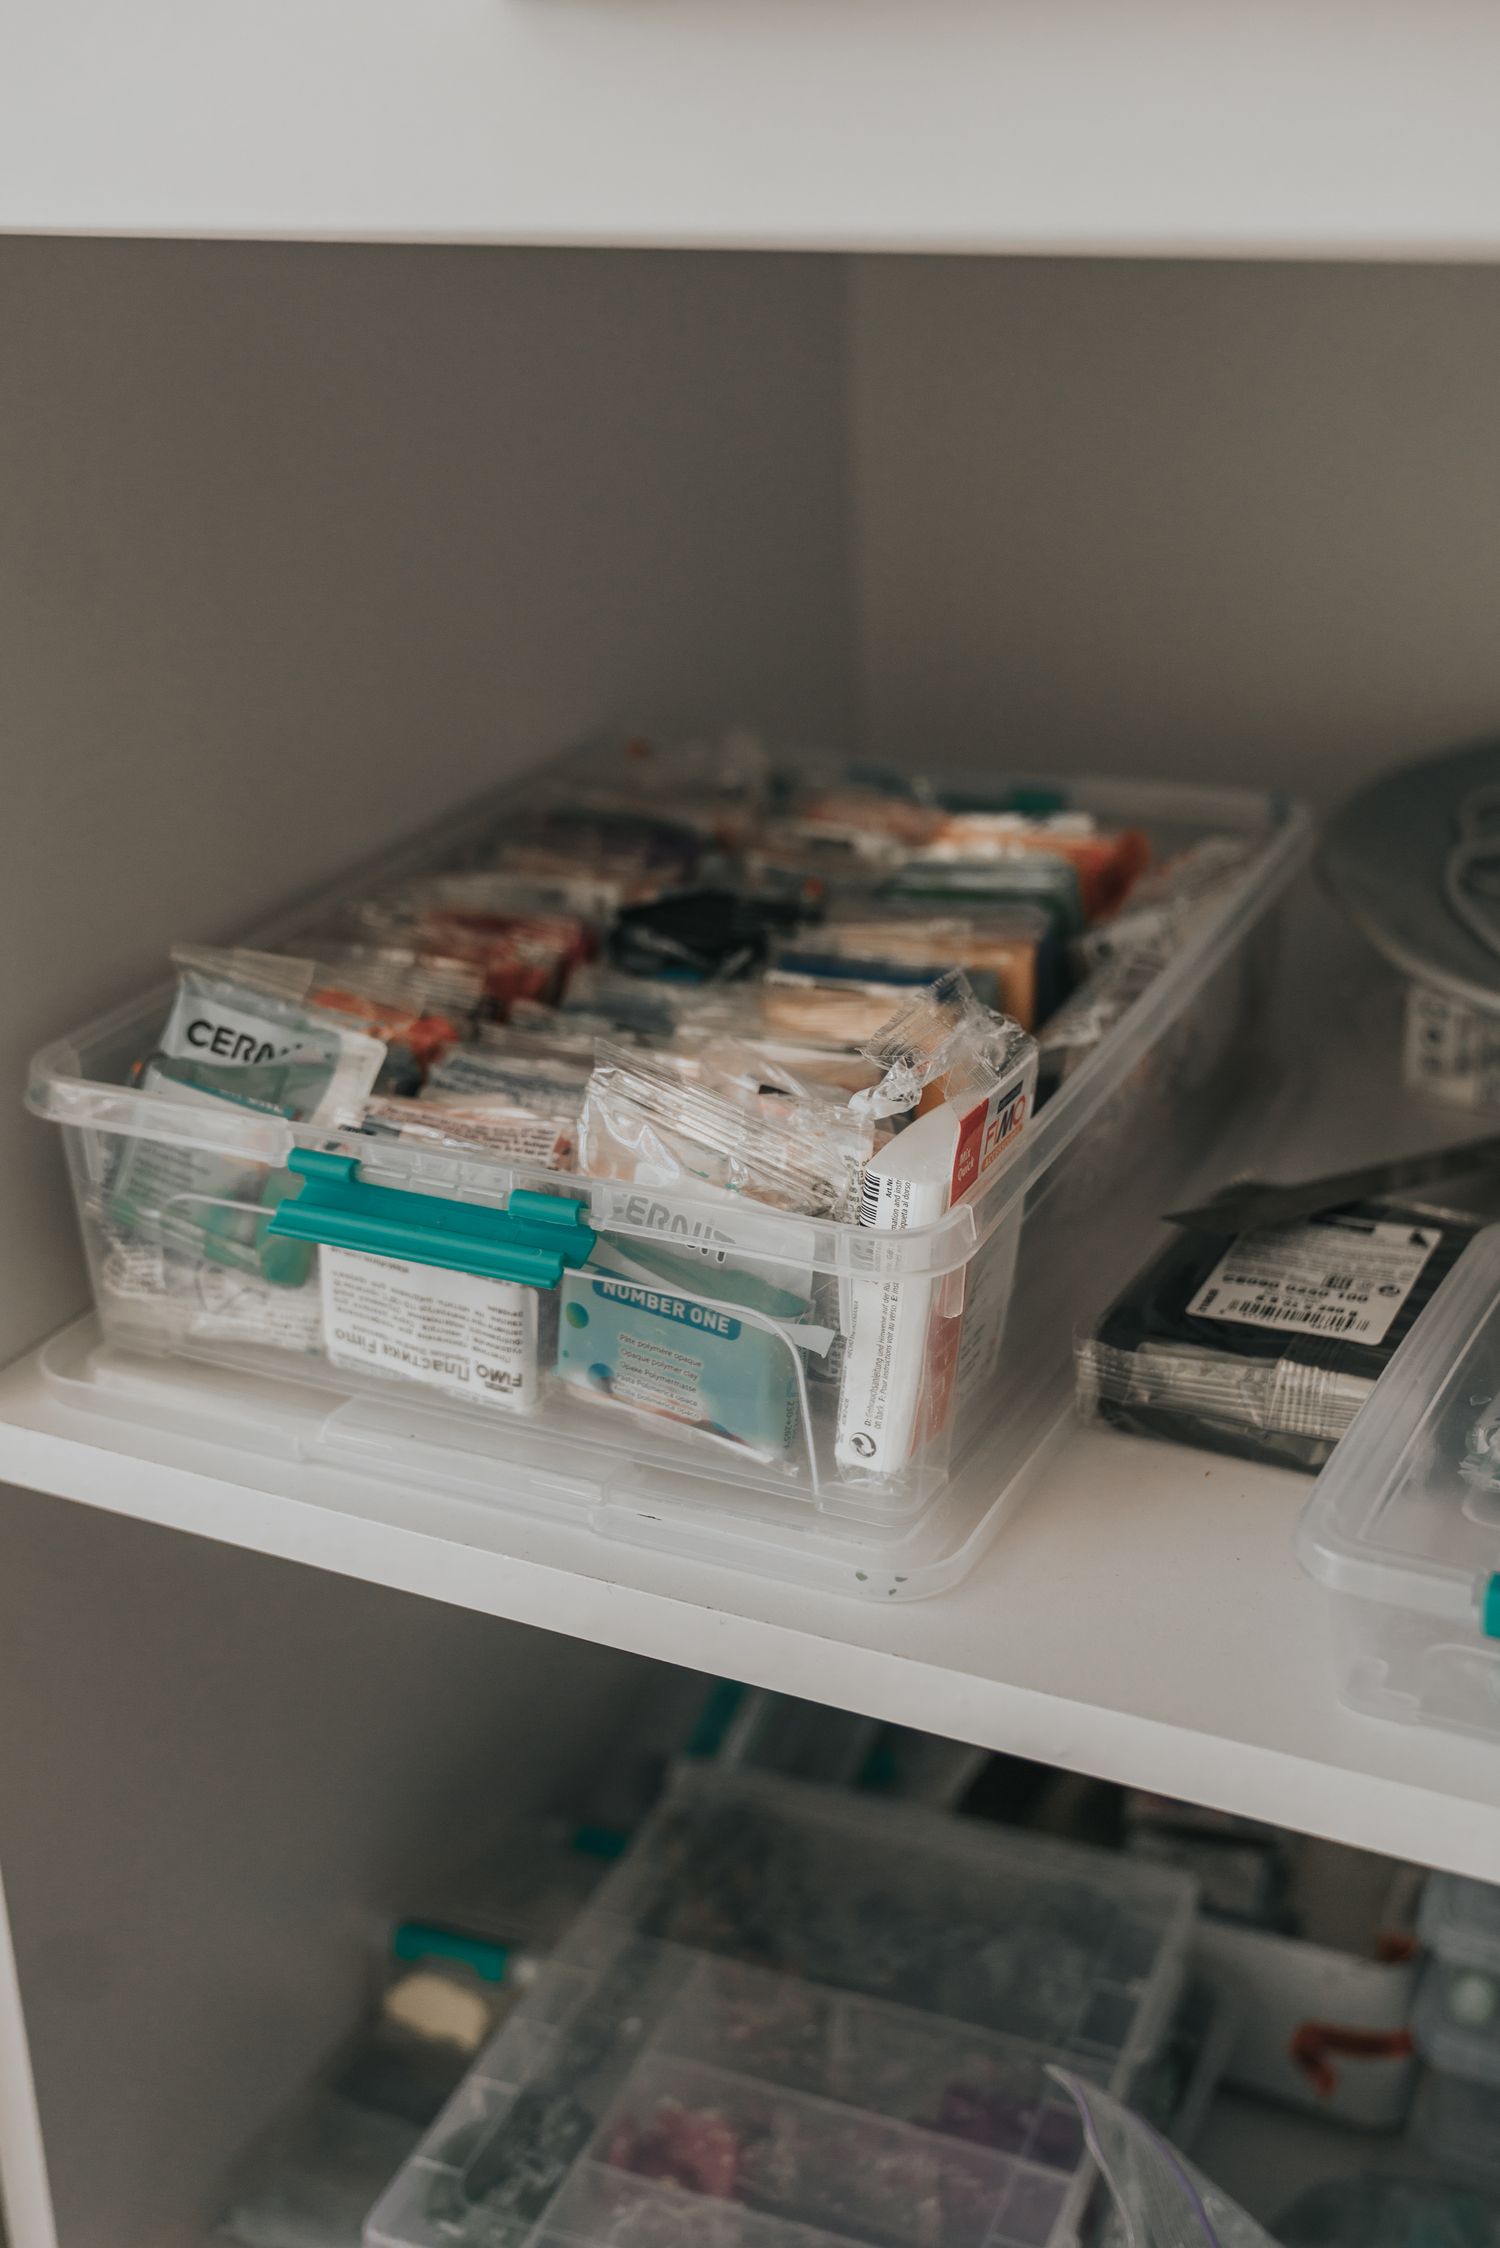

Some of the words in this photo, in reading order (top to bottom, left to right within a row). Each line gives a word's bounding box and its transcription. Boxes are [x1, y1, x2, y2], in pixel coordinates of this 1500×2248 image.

[984, 1095, 1026, 1155] FIMO
[893, 1178, 902, 1194] instr
[893, 1195, 901, 1208] and
[901, 1200, 909, 1208] al
[891, 1209, 899, 1230] mation
[602, 1282, 686, 1320] NUMBER
[690, 1307, 732, 1335] ONE
[334, 1327, 377, 1355] Fimo
[875, 1344, 885, 1357] und
[383, 1343, 470, 1383] Пластика
[881, 1345, 893, 1380] instructions
[475, 1362, 522, 1388] FIMO
[879, 1380, 888, 1394] Pour
